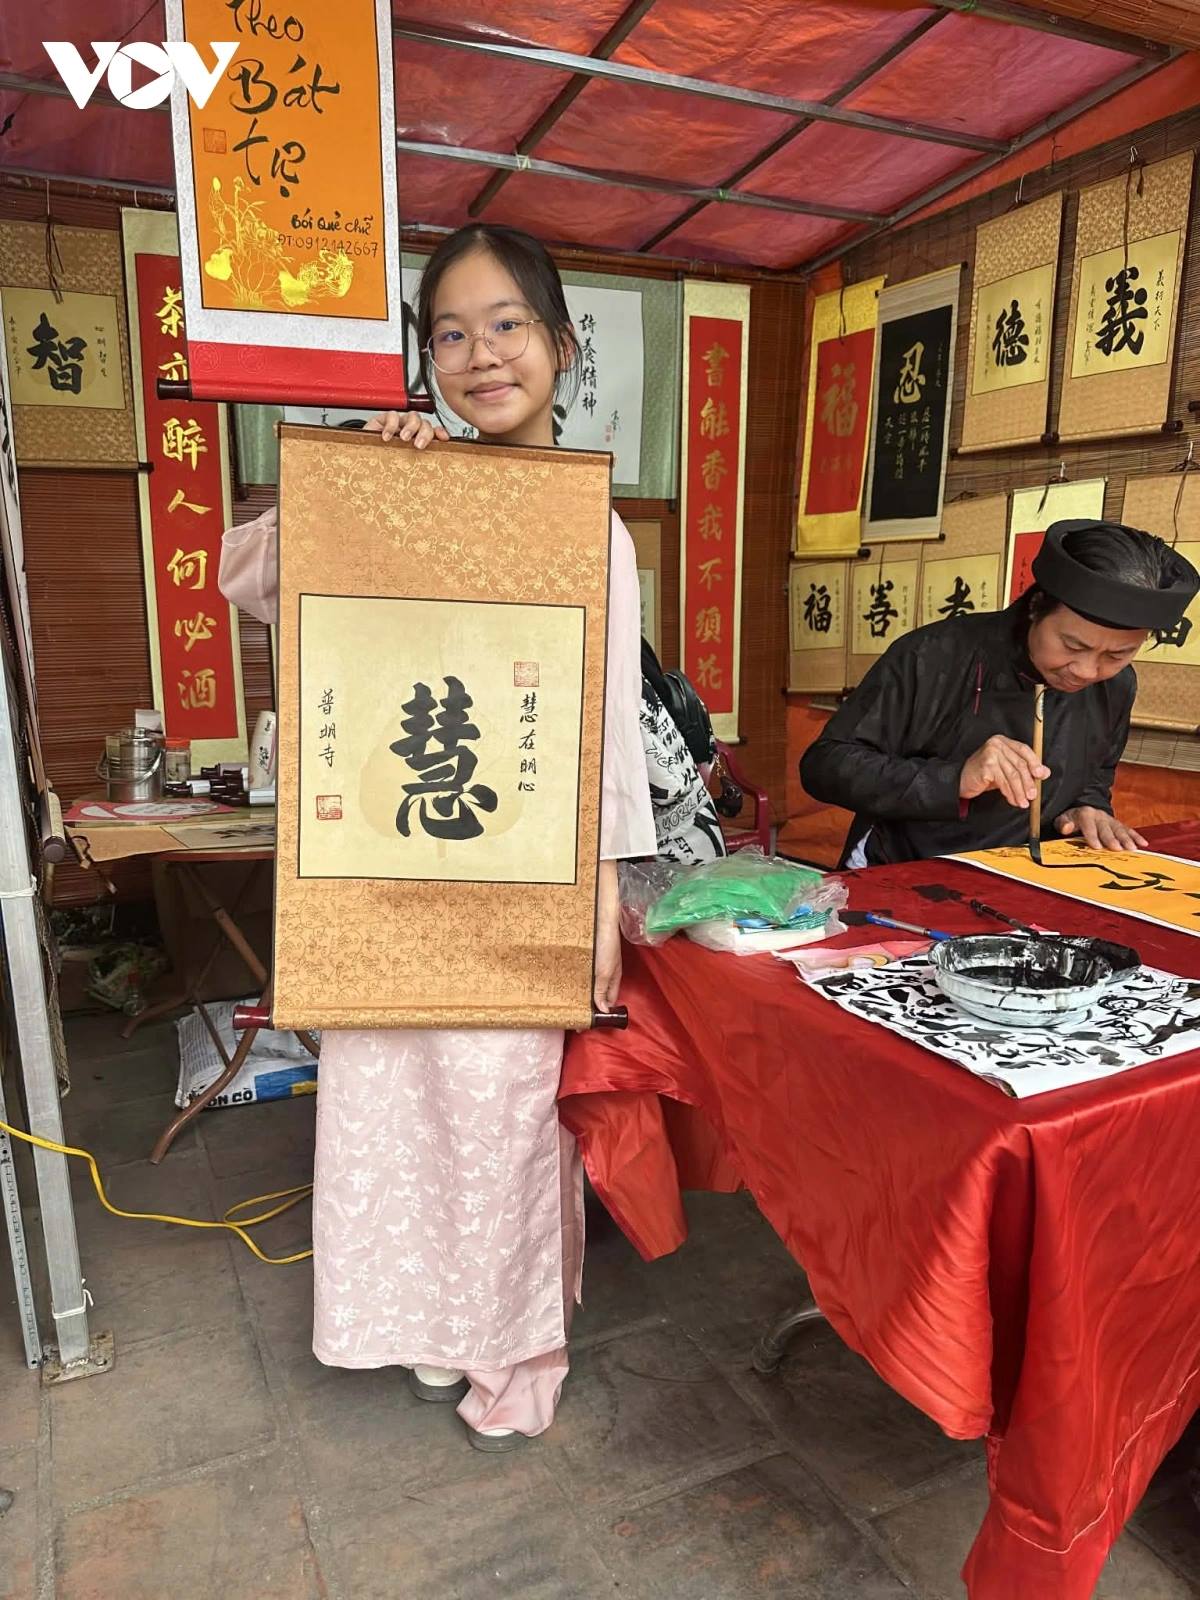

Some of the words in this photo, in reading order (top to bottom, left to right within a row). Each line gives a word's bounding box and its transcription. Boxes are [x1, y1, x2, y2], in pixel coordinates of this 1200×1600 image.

[226, 0, 304, 42] Theo
[226, 54, 341, 115] Bát
[290, 207, 314, 230] Bói
[26, 311, 88, 395] 智
[992, 299, 1031, 368] 德
[803, 583, 833, 634] 福
[863, 580, 899, 638] 善
[389, 676, 498, 840] 慧
[518, 691, 538, 792] 慧在明心
